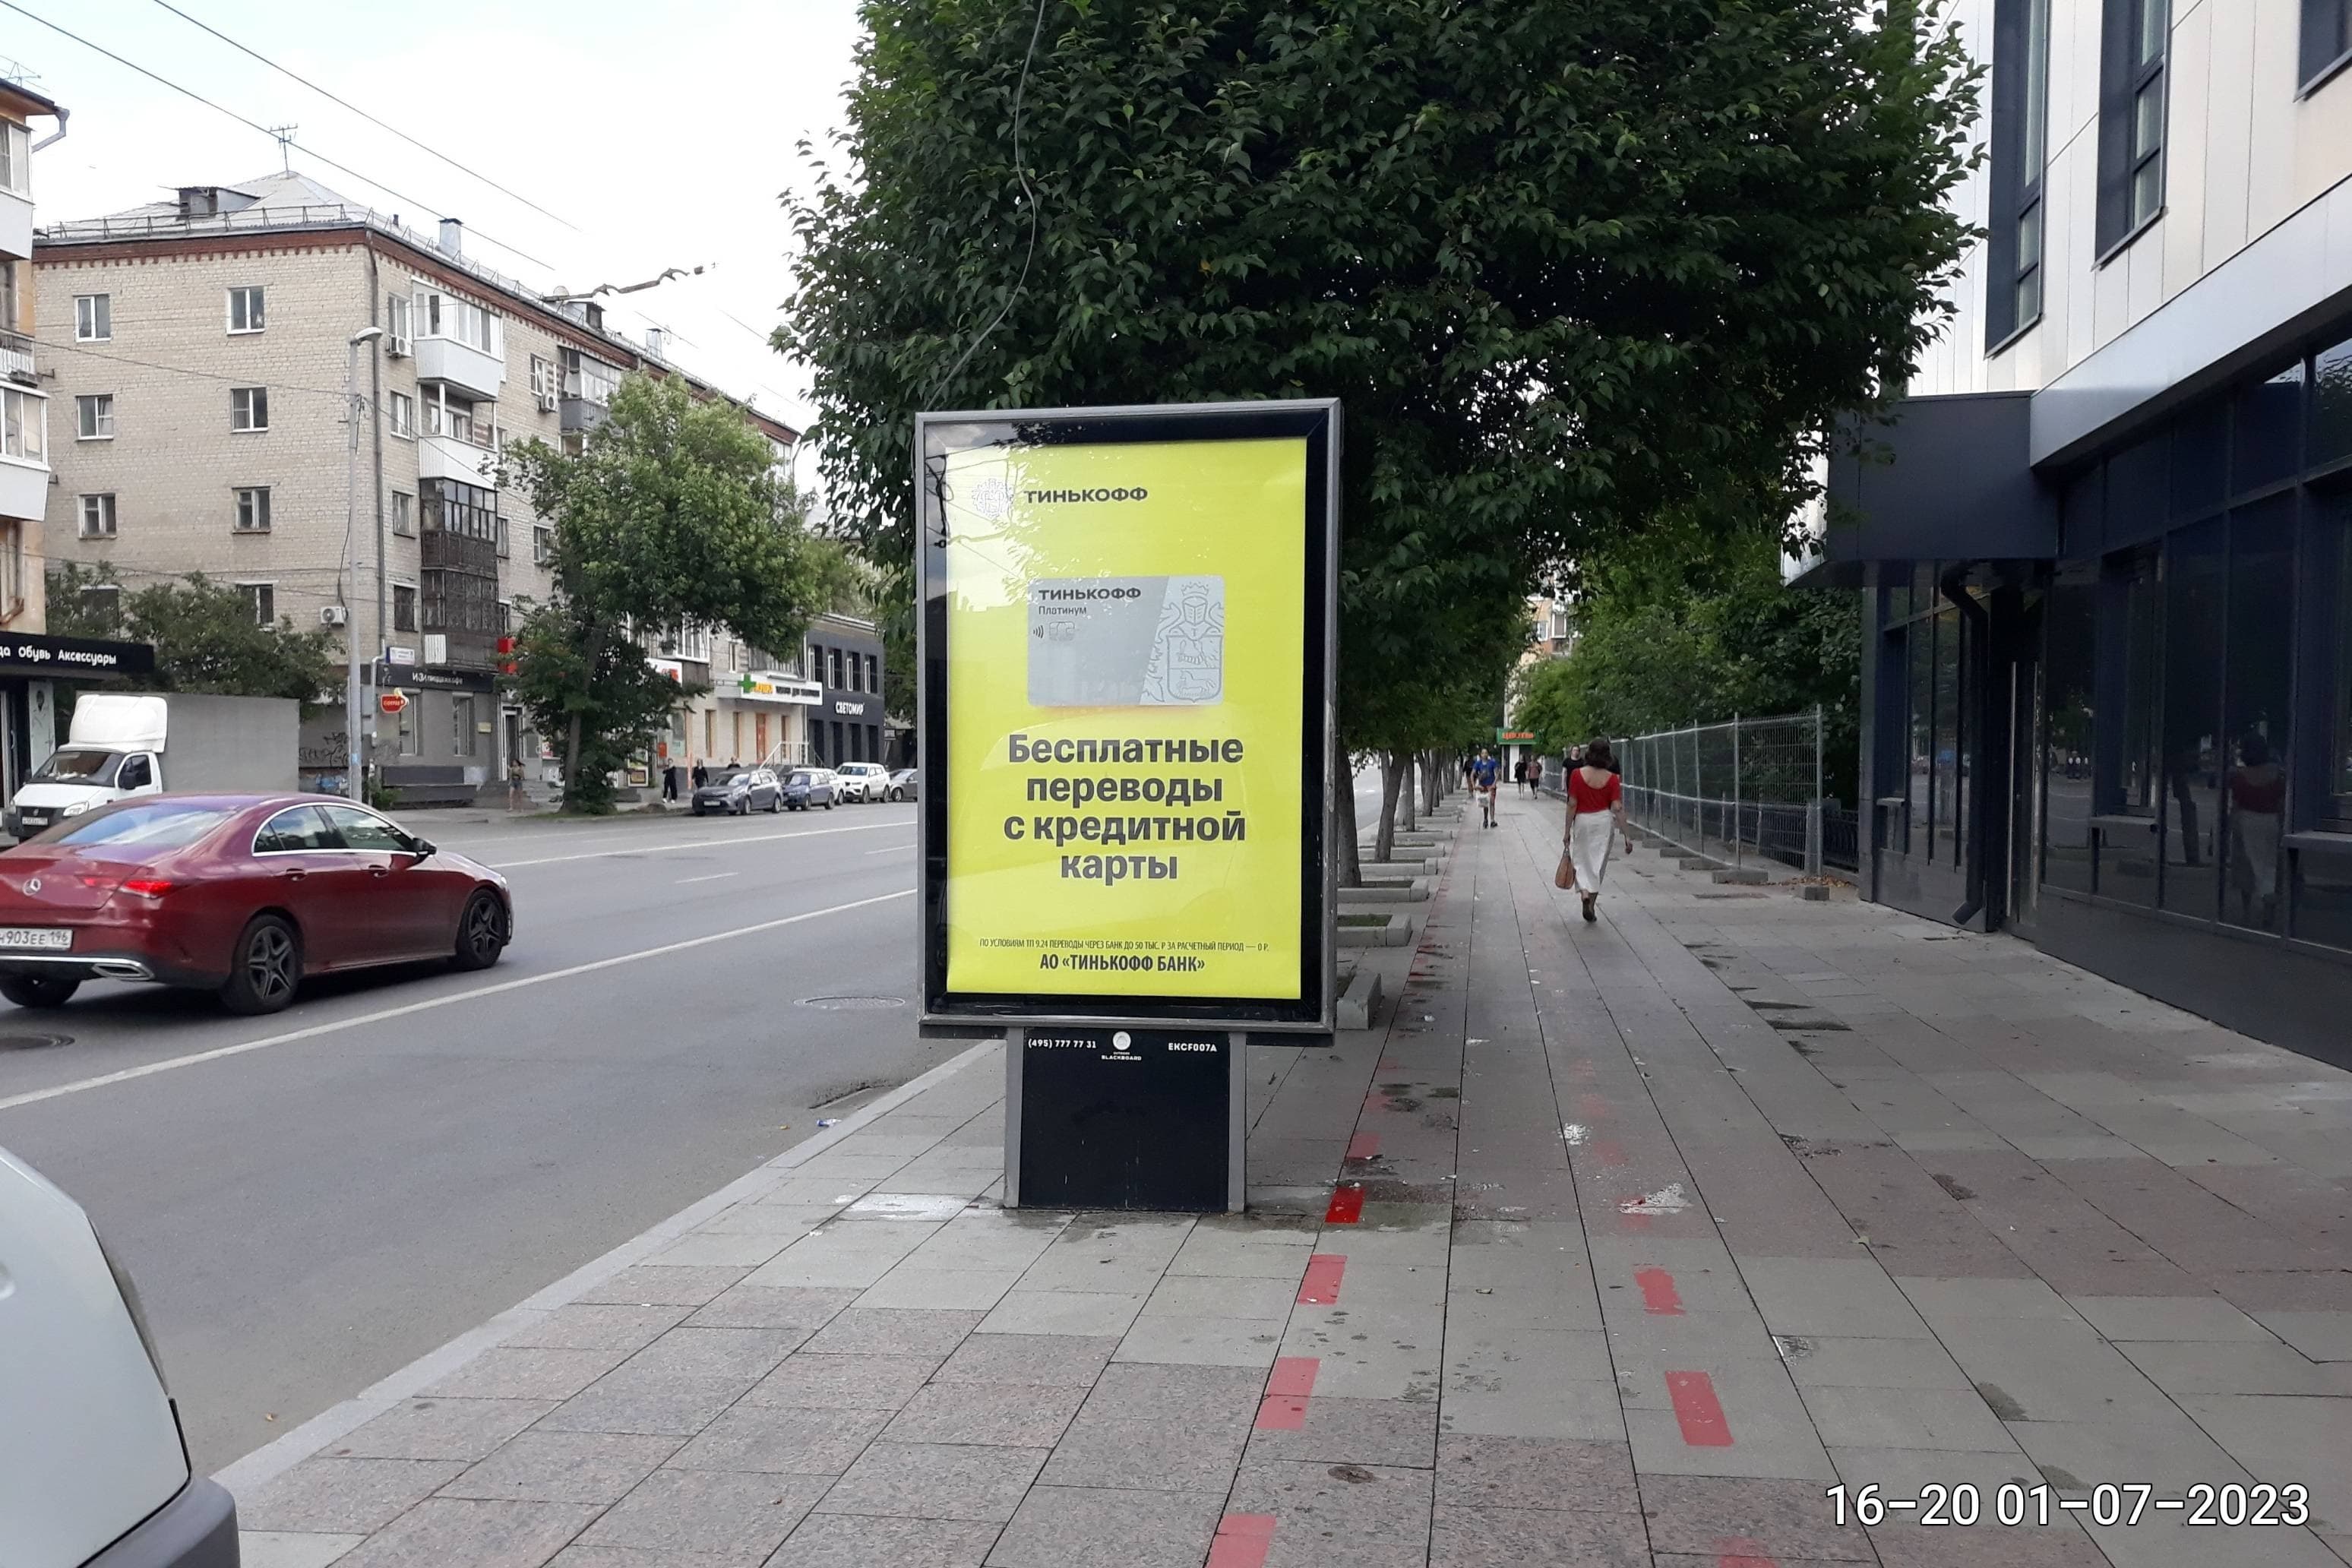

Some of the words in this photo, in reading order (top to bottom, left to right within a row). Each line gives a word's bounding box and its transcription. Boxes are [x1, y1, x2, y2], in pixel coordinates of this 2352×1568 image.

[1025, 487, 1148, 504] ТИНЬКОФФ
[1038, 587, 1141, 601] ТИНЬКОФФ
[1038, 605, 1087, 617] Платинум
[18, 645, 51, 662] Обувь
[58, 650, 116, 666] Аксессуары
[836, 701, 864, 715] СВЕТОМИР
[1009, 734, 1244, 763] Бесплатные
[1027, 778, 1222, 808] переводы
[1004, 816, 1025, 839] с
[1034, 810, 1245, 846] кредитной
[1061, 855, 1178, 886] карты
[980, 938, 988, 947] ПО
[990, 938, 1025, 947] УСЛОВИЯМ
[1035, 940, 1048, 948] 9.24
[1050, 940, 1083, 949] ПЕРЕВОДЫ
[1085, 940, 1105, 949] ЧЕРЕЗ
[1105, 940, 1123, 949] БАНК
[1124, 941, 1133, 950] ДО
[1135, 941, 1143, 950] 50
[1145, 941, 1160, 950] ТЫС.
[1178, 941, 1216, 950] РАСЧЕТНЫЙ
[1218, 942, 1244, 951] ПЕРИОД
[1040, 953, 1059, 969] АО
[1062, 954, 1153, 972] «ТИНЬКОФФ
[1157, 956, 1206, 972] БАНК»
[1028, 1038, 1052, 1048] (495)
[1054, 1039, 1070, 1048] 777
[1073, 1040, 1083, 1048] 77
[1086, 1040, 1097, 1048] 31
